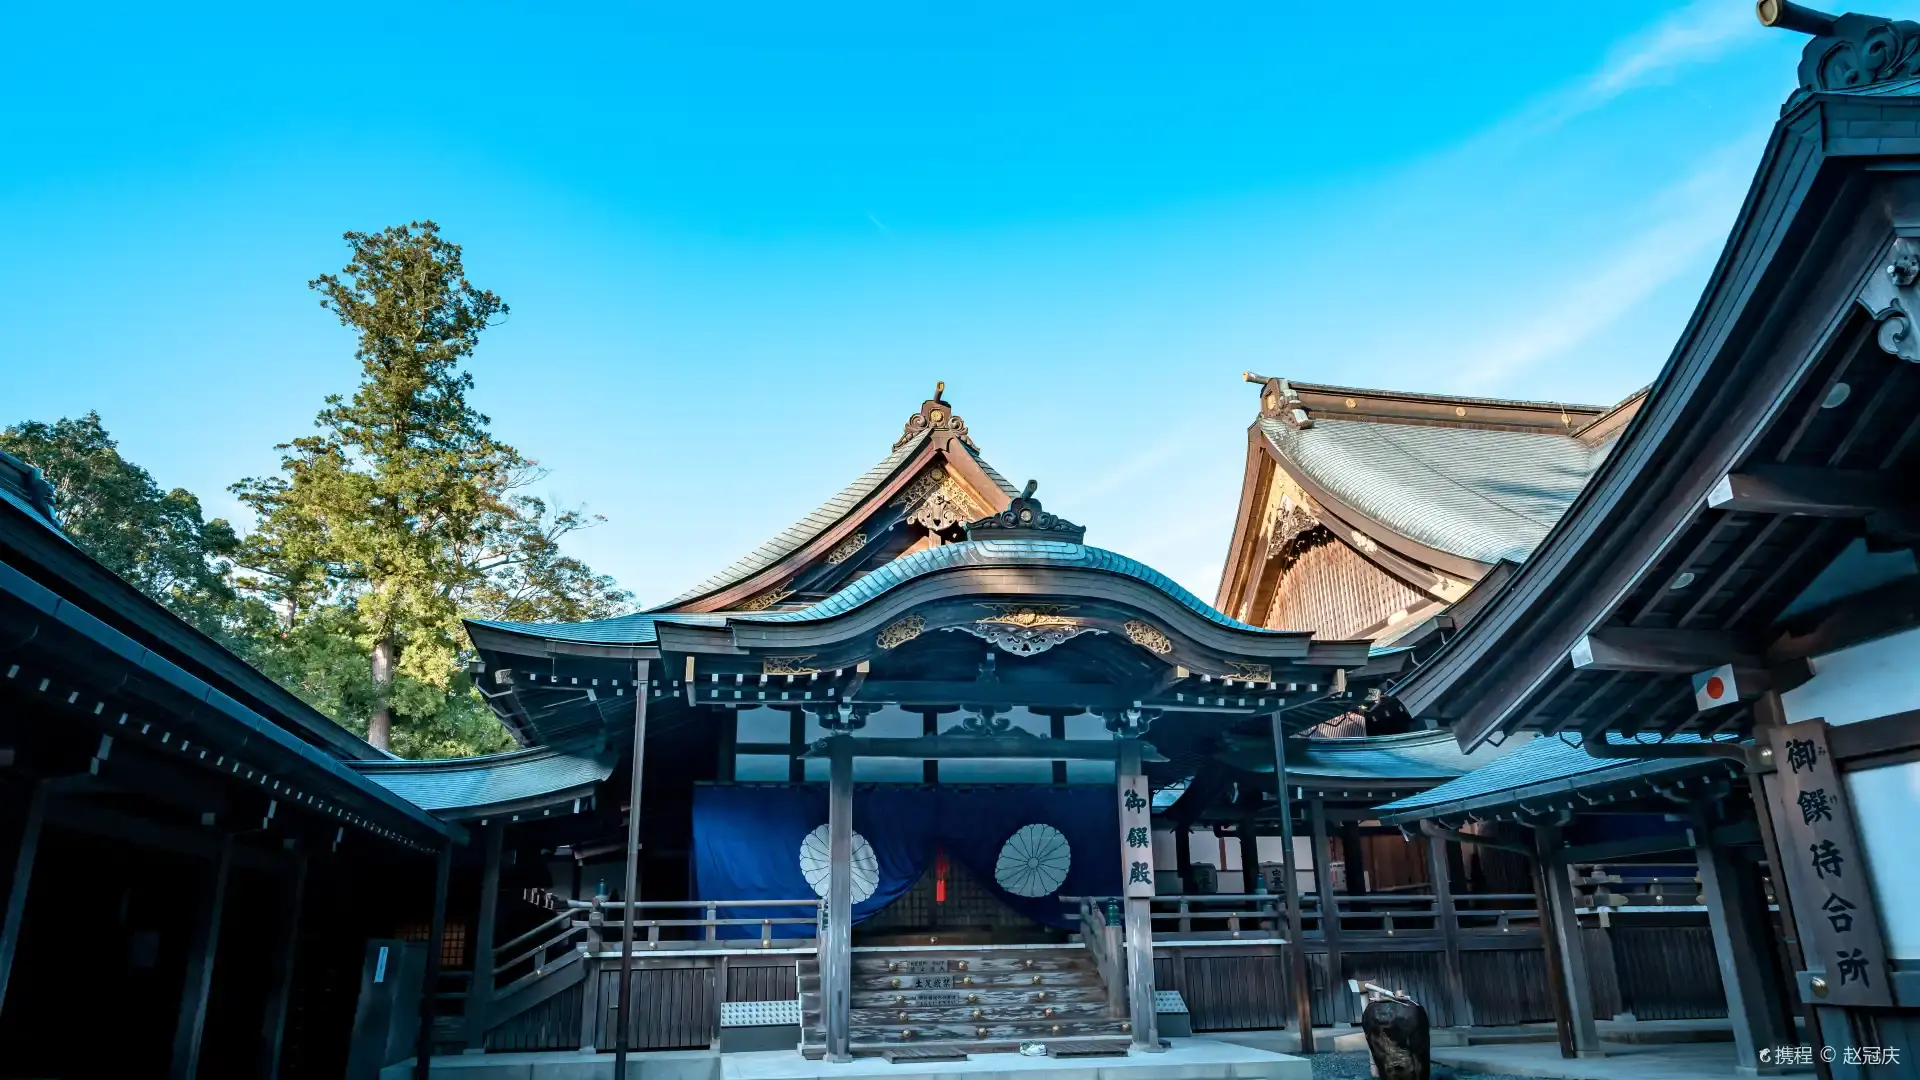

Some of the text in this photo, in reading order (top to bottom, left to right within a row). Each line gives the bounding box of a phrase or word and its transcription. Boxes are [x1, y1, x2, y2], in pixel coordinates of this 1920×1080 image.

[1124, 788, 1152, 885] 御饌殿
[1785, 738, 1870, 988] 御饌待合所
